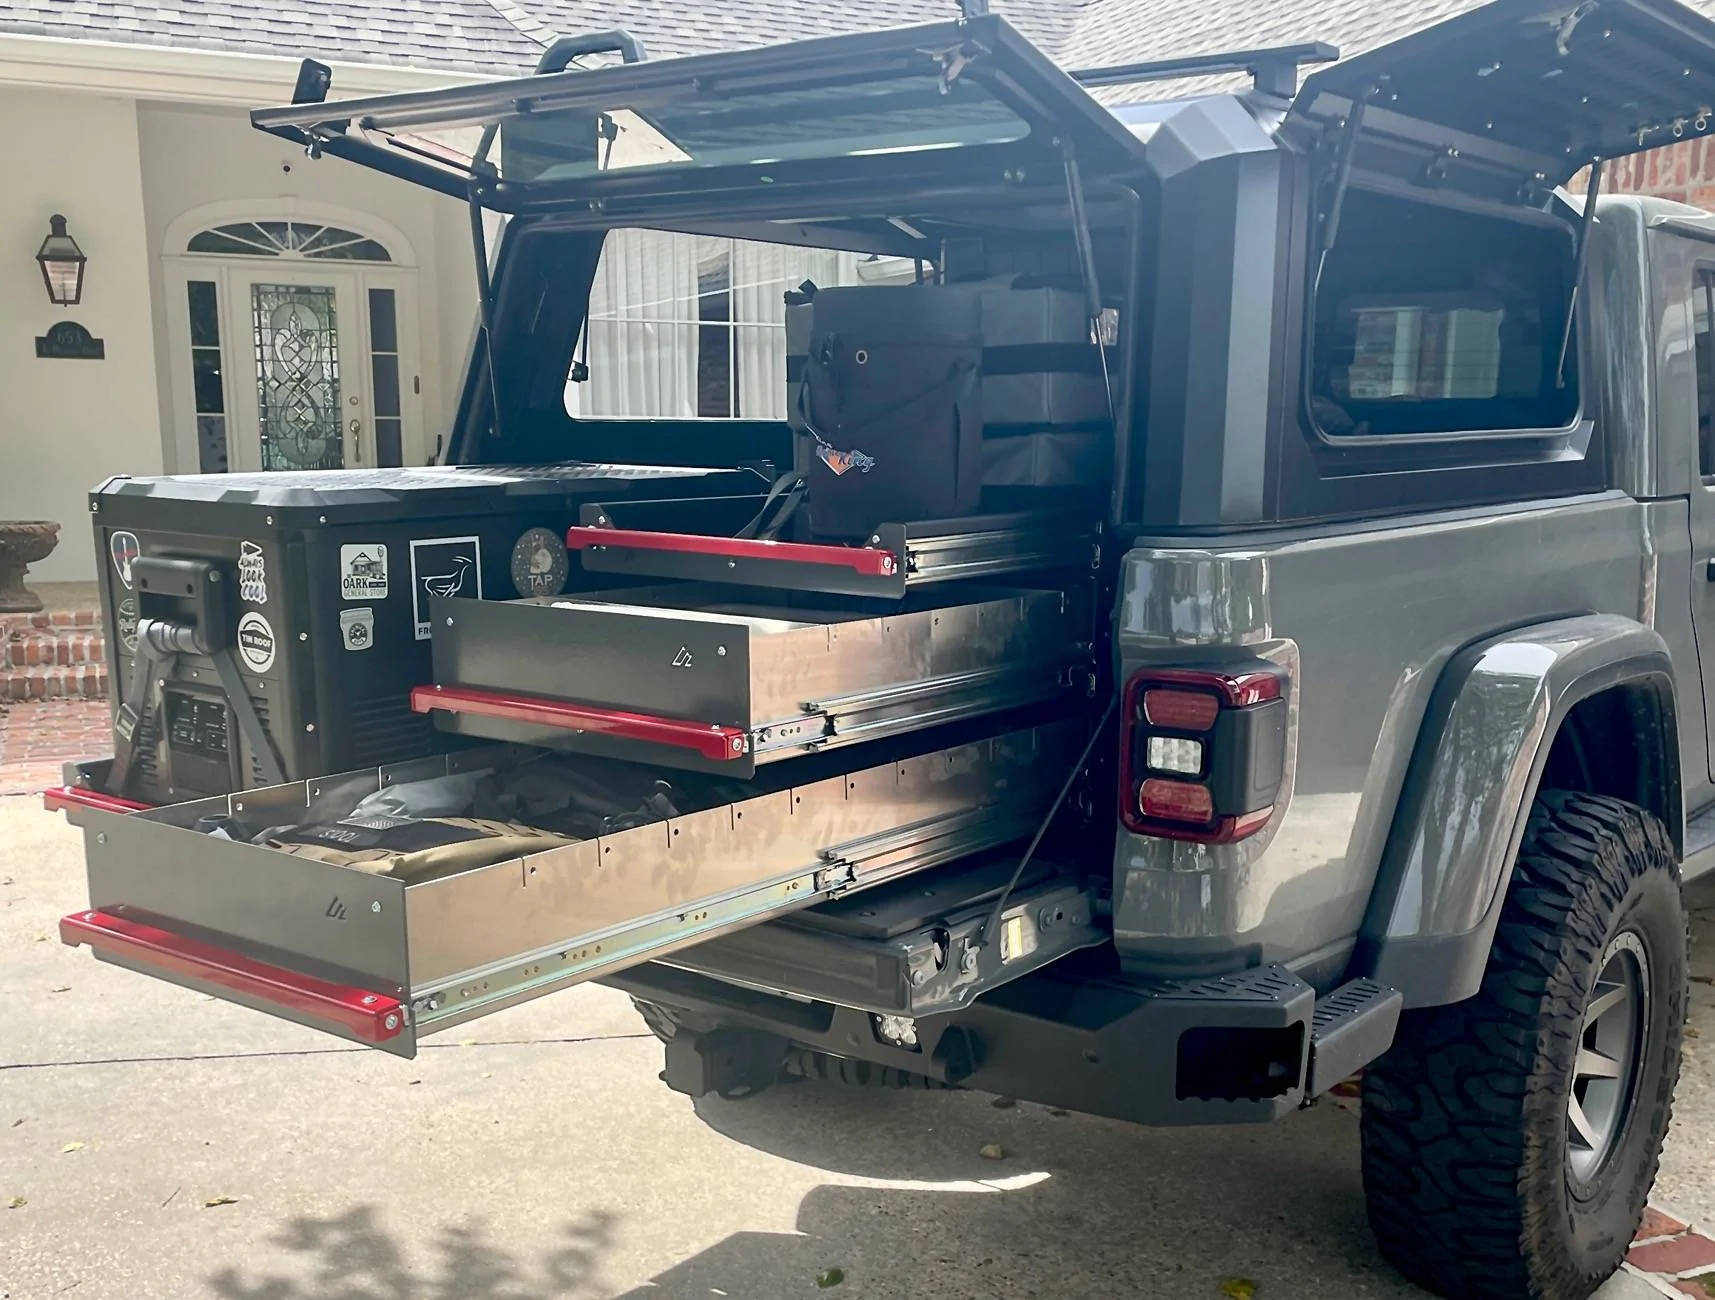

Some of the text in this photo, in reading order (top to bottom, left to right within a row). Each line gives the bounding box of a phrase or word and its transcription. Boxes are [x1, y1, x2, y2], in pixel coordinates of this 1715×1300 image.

[241, 569, 264, 584] LOOK
[343, 577, 368, 589] OARK
[527, 574, 553, 591] TAP
[242, 583, 266, 602] COOL
[241, 633, 271, 648] TIN ROOF
